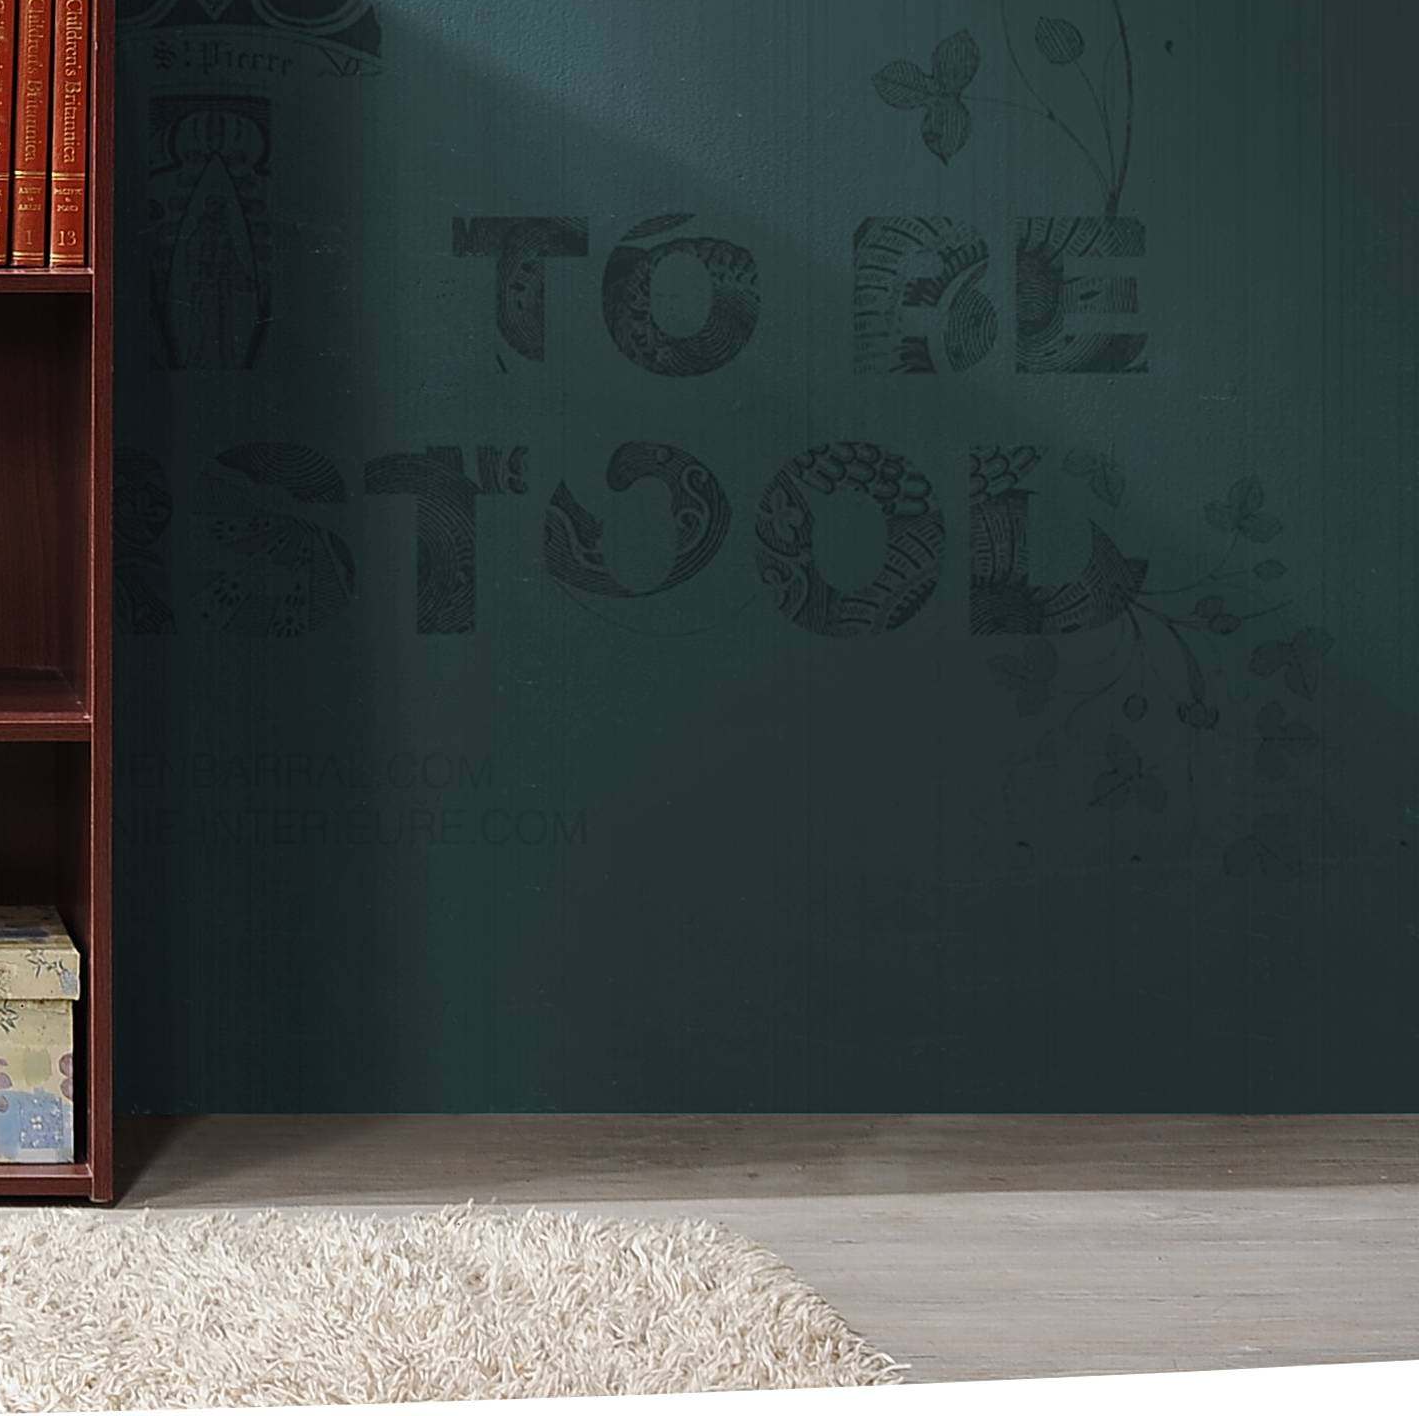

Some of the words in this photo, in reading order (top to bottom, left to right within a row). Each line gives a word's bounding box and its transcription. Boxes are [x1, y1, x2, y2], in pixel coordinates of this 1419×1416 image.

[62, 78, 82, 164] Britannica
[58, 230, 76, 246] 13
[452, 211, 761, 377] TO
[853, 216, 1150, 374] BE
[115, 440, 1150, 639] STOOD
